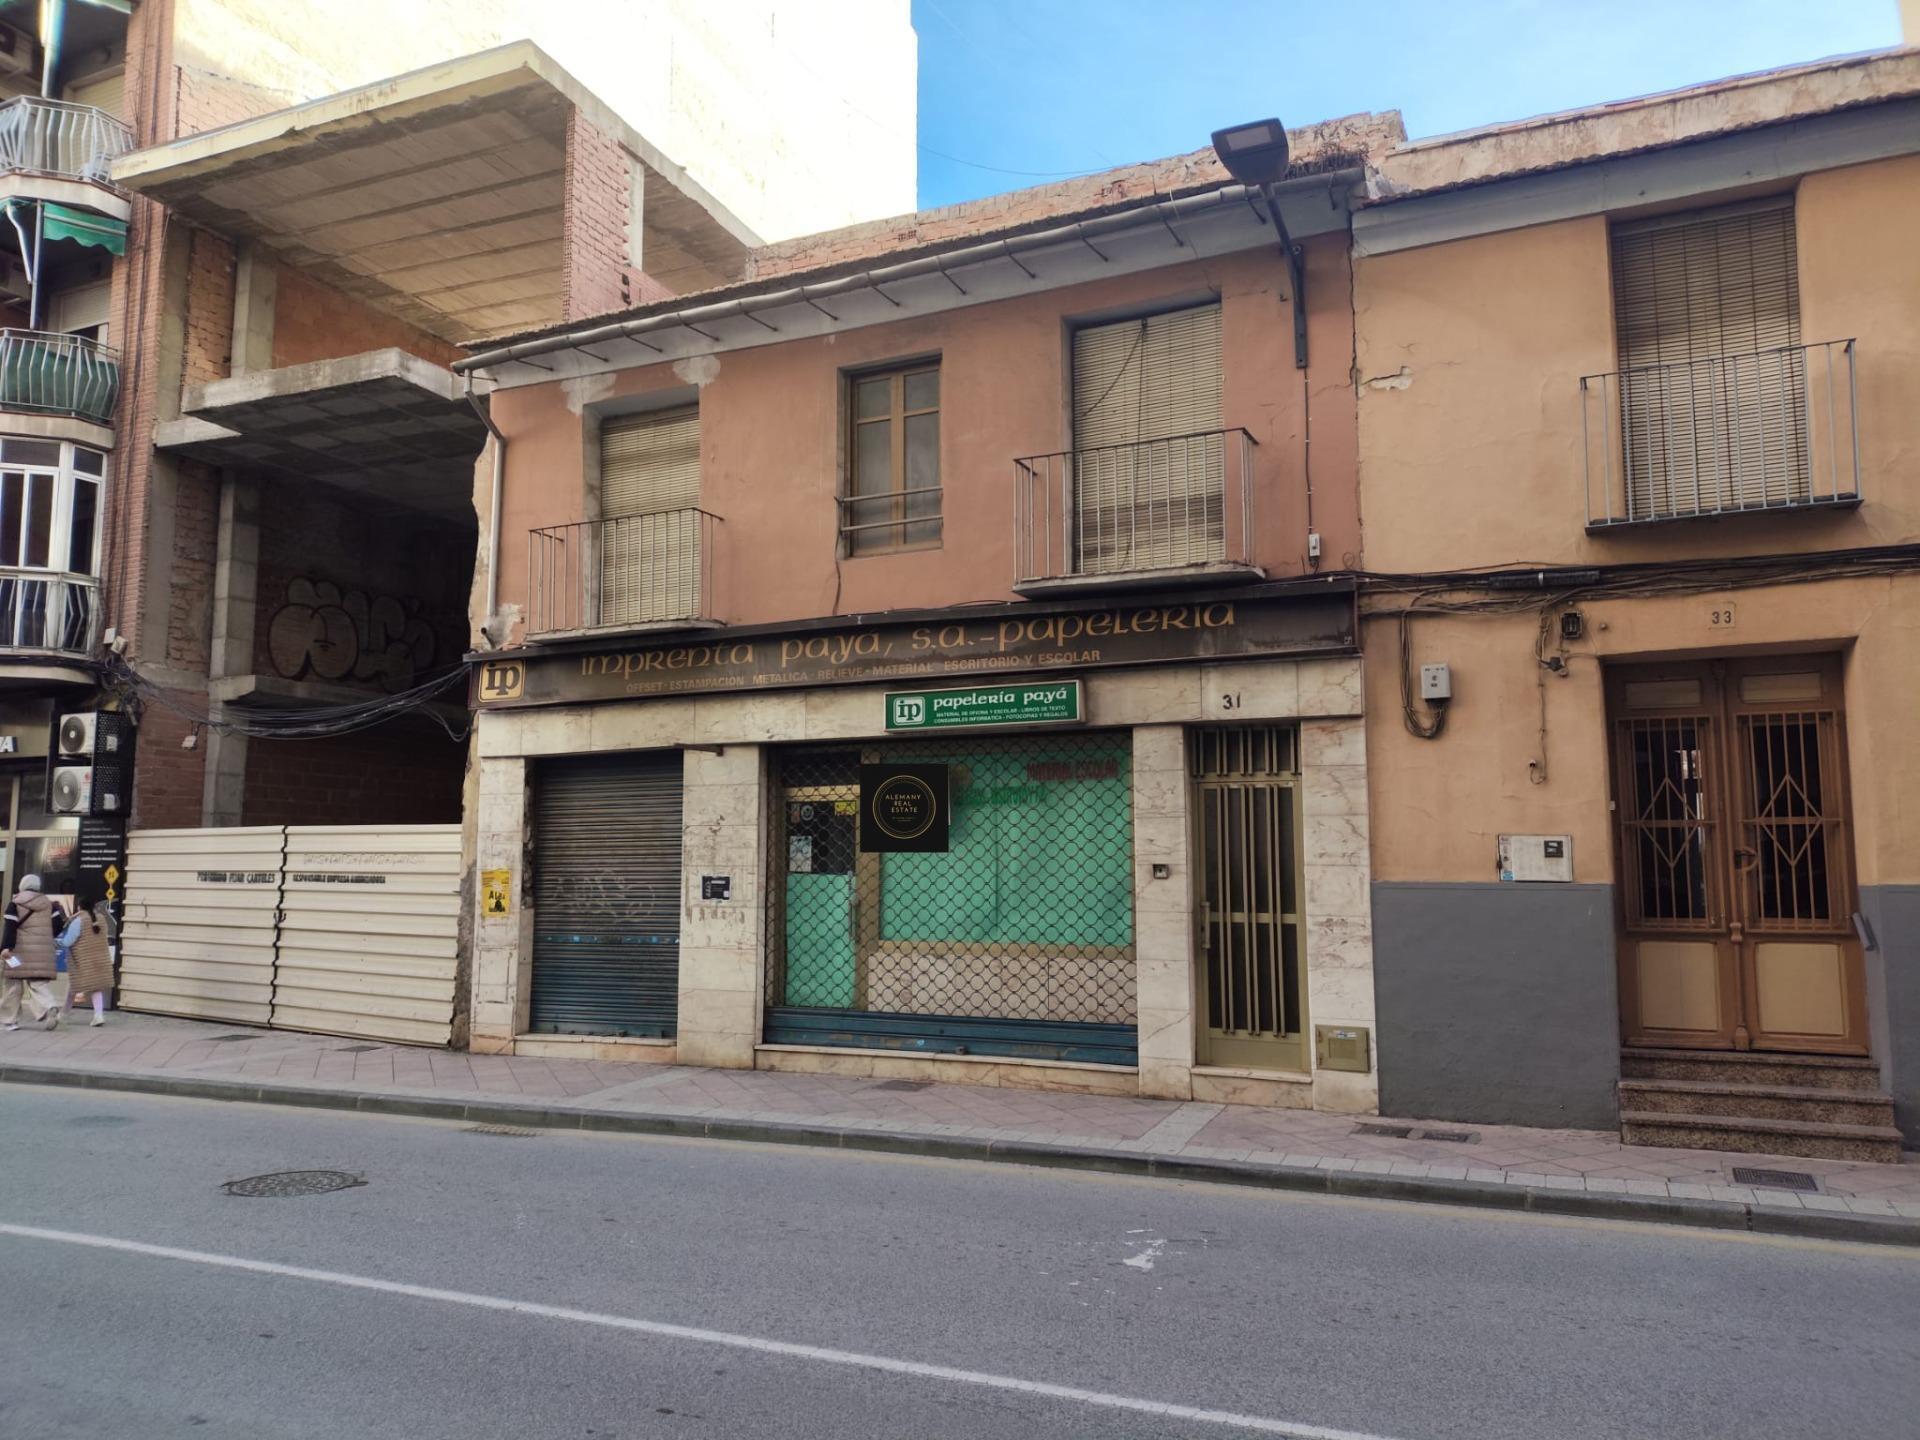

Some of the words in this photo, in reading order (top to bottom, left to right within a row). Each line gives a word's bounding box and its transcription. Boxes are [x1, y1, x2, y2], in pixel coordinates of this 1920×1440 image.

[1711, 610, 1732, 624] 33
[752, 670, 809, 685] METALICA
[817, 667, 864, 680] RELIEVE
[872, 662, 934, 675] MATERIAL
[944, 655, 1020, 671] ESCRITORIO
[1024, 654, 1034, 665] Y
[1038, 649, 1101, 665] ESCOLAR
[485, 661, 521, 696] ip
[1023, 687, 1068, 705] payá
[1222, 691, 1241, 710] 31
[897, 697, 922, 721] ip
